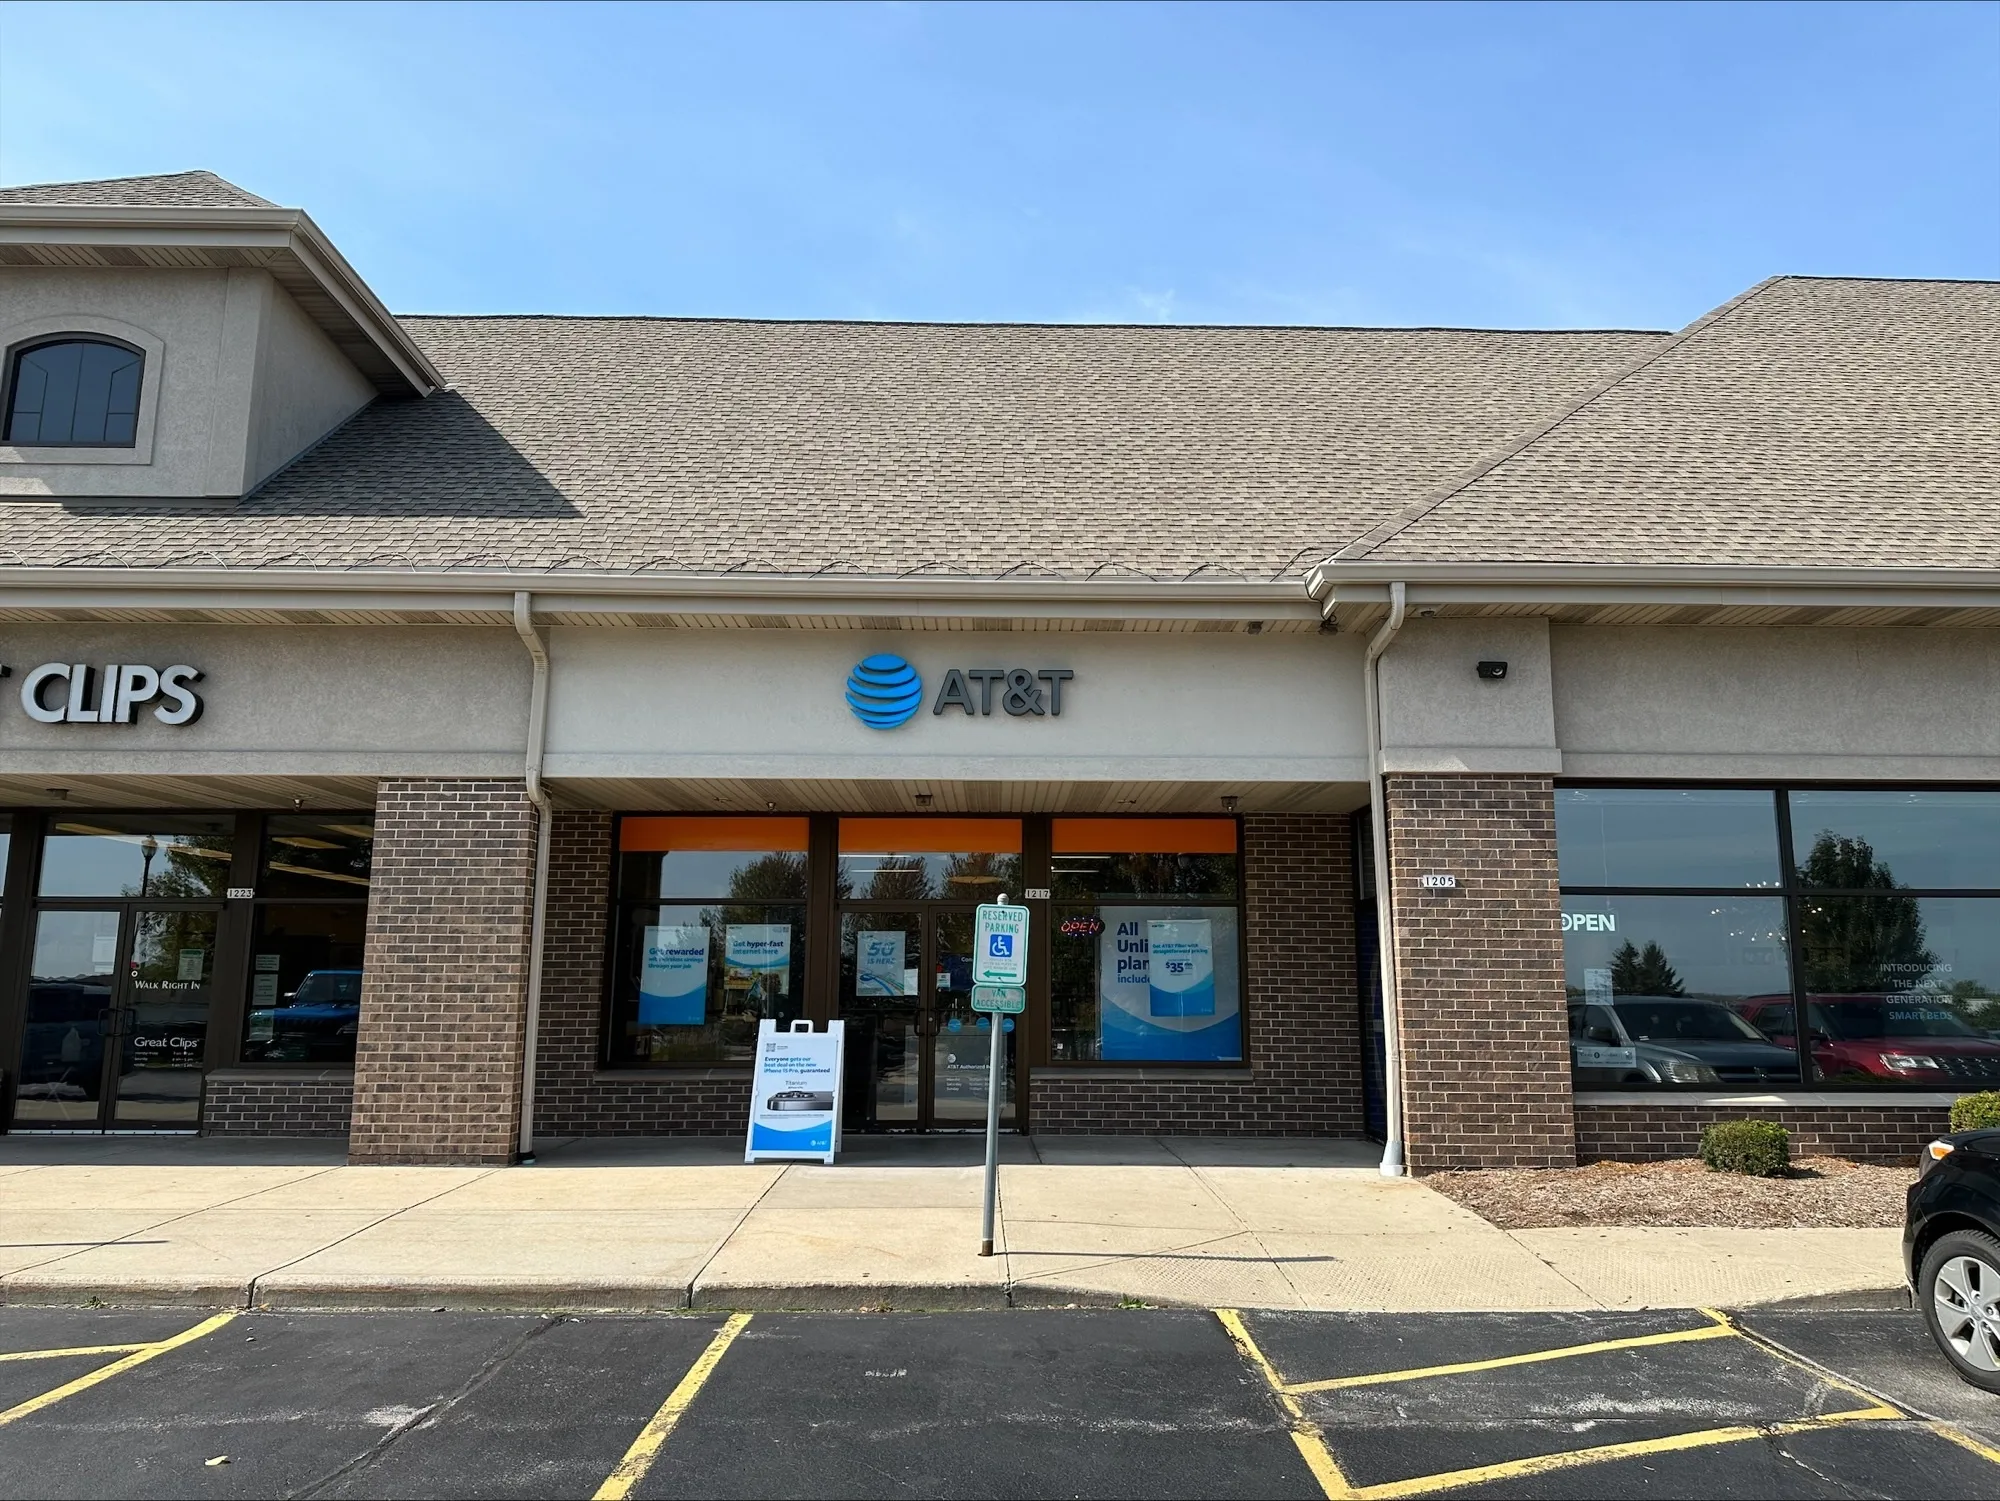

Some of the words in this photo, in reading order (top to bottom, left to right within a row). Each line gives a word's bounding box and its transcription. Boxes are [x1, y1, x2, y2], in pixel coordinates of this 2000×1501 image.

[21, 663, 204, 726] CLIPS
[933, 669, 1074, 716] AT&T
[1425, 876, 1455, 886] 1205
[229, 889, 252, 898] 1223
[1026, 890, 1049, 898] 1217
[982, 910, 1023, 922] RESERVED
[1061, 921, 1100, 932] OPEN
[1560, 913, 1616, 932] OPEN
[984, 922, 1019, 934] PARKING
[1117, 921, 1139, 936] All
[746, 940, 784, 949] hyper-fast
[666, 947, 705, 956] rewarded
[1165, 961, 1184, 973] $35
[1880, 963, 1953, 972] INTRODUCING
[1892, 979, 1912, 988] THE
[1915, 979, 1942, 988] NEXT
[991, 989, 1007, 998] VAN
[975, 999, 1021, 1009] ACCESSIBLE
[1886, 995, 1953, 1004] GENERATION
[1889, 1011, 1923, 1020] SMART
[1926, 1011, 1953, 1020] BEDS
[134, 1036, 168, 1047] Great
[169, 1036, 198, 1050] Clips
